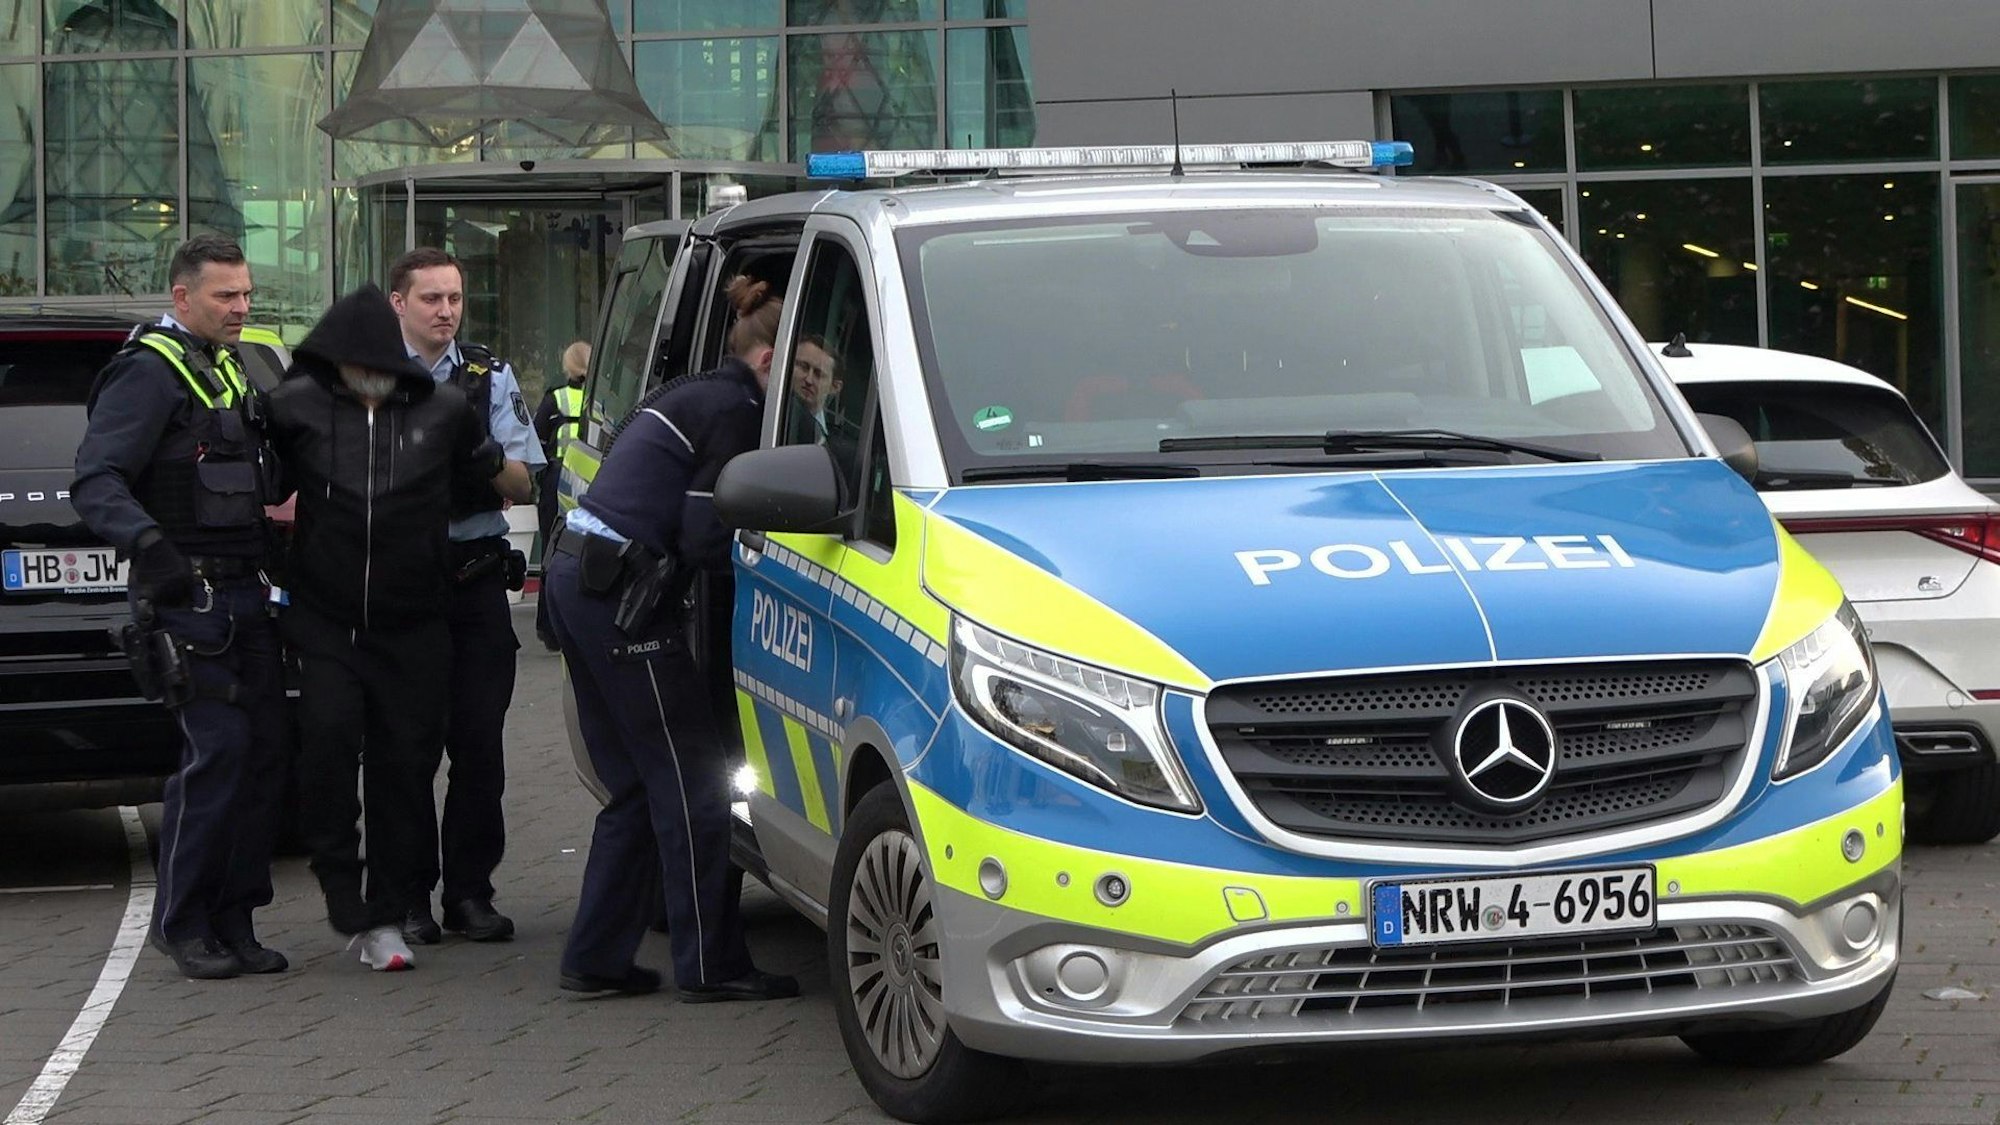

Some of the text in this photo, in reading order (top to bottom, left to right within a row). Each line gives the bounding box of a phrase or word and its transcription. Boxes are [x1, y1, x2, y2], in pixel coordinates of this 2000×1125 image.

[23, 554, 119, 584] HB JW
[1234, 533, 1636, 586] POLIZEI
[627, 640, 660, 654] POLIZEI
[751, 588, 813, 673] POLIZEI
[1401, 873, 1651, 935] NRW 4-6956
[1383, 921, 1394, 934] D
